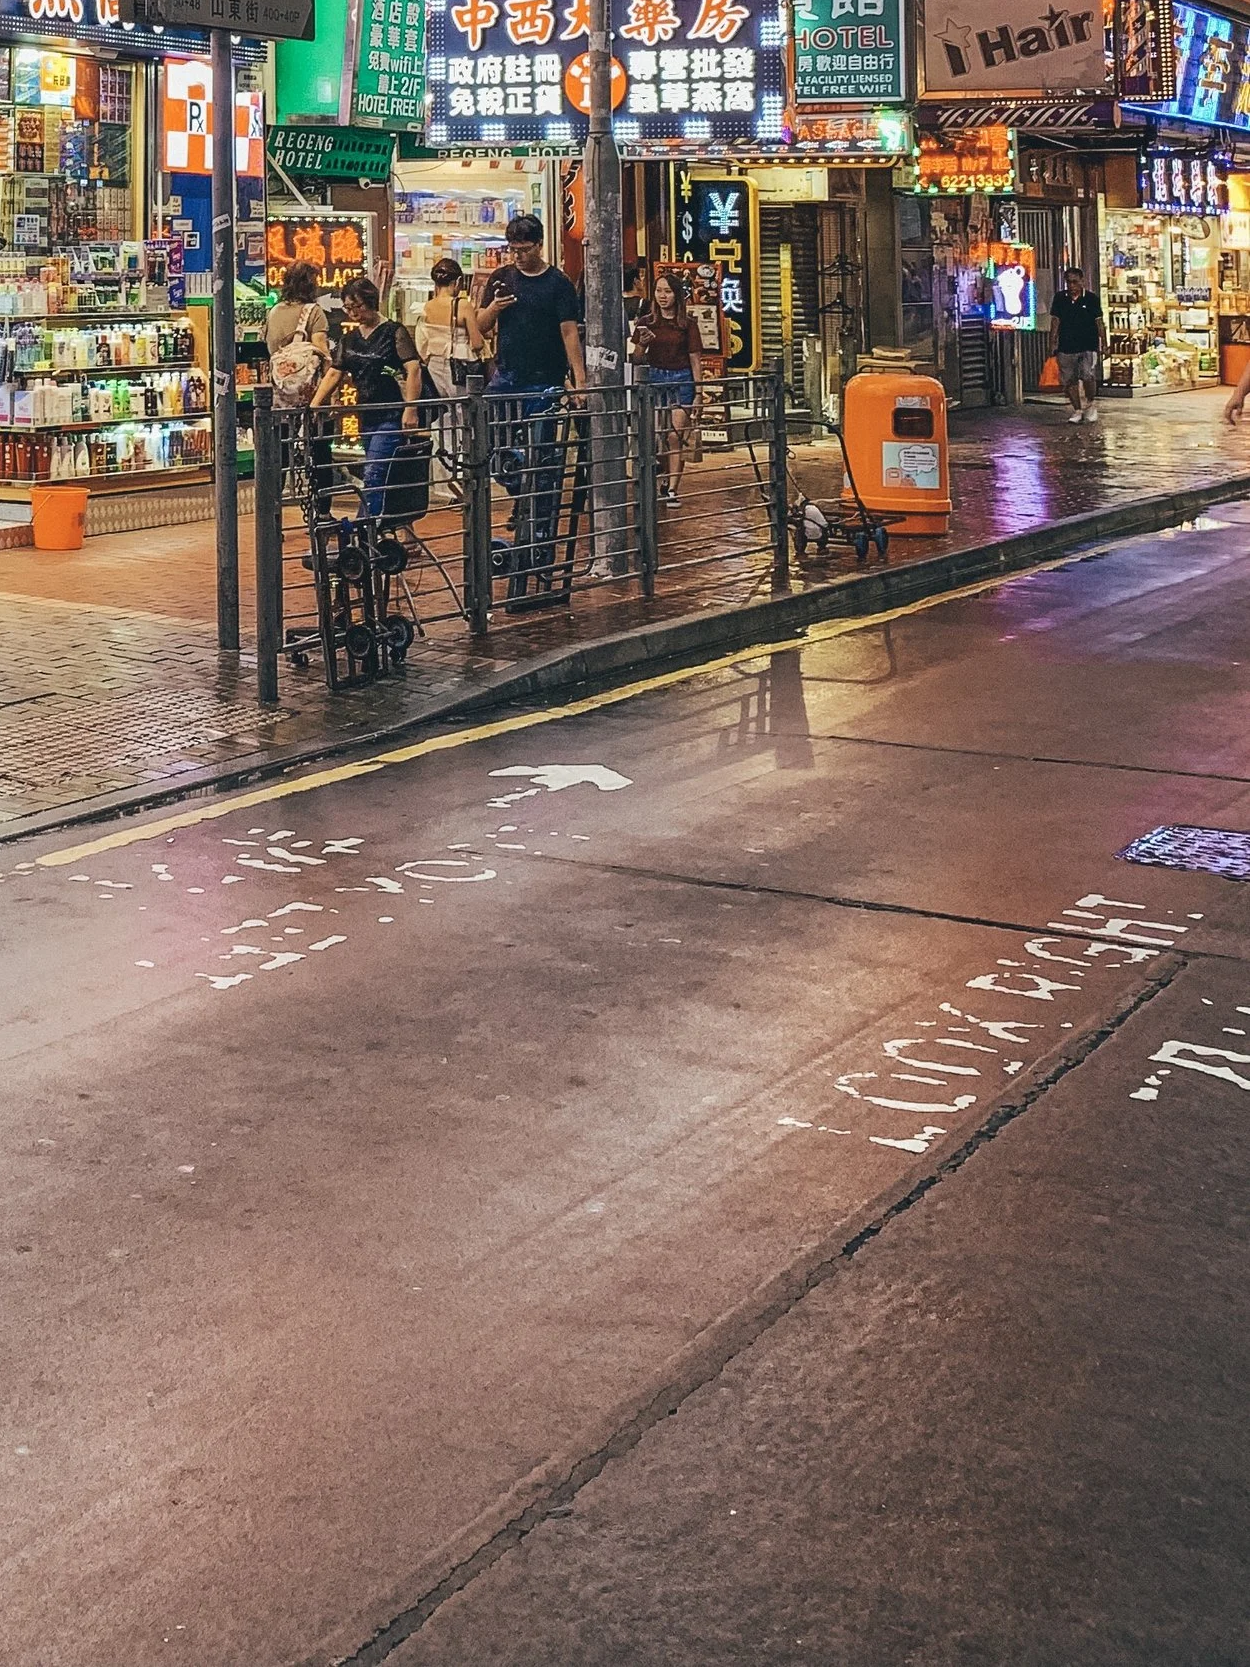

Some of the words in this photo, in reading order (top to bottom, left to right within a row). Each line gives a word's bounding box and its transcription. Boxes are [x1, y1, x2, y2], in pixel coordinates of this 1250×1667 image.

[370, 24, 426, 53] 豪華套
[980, 4, 1094, 68] Hair
[368, 50, 425, 76] 免費wifi上
[448, 54, 561, 87] 政府註冊
[816, 54, 895, 71] 歡迎自由行
[805, 75, 848, 84] FACILITY
[851, 74, 893, 83] LIENSED
[823, 85, 855, 94] FREE
[860, 84, 892, 93] WIFI
[358, 94, 389, 115] HOTEL
[391, 95, 415, 117] FREE
[274, 131, 334, 152] REGENG
[274, 149, 322, 170] HOTEL
[438, 148, 512, 159] REGENG
[529, 147, 585, 158] HOTE
